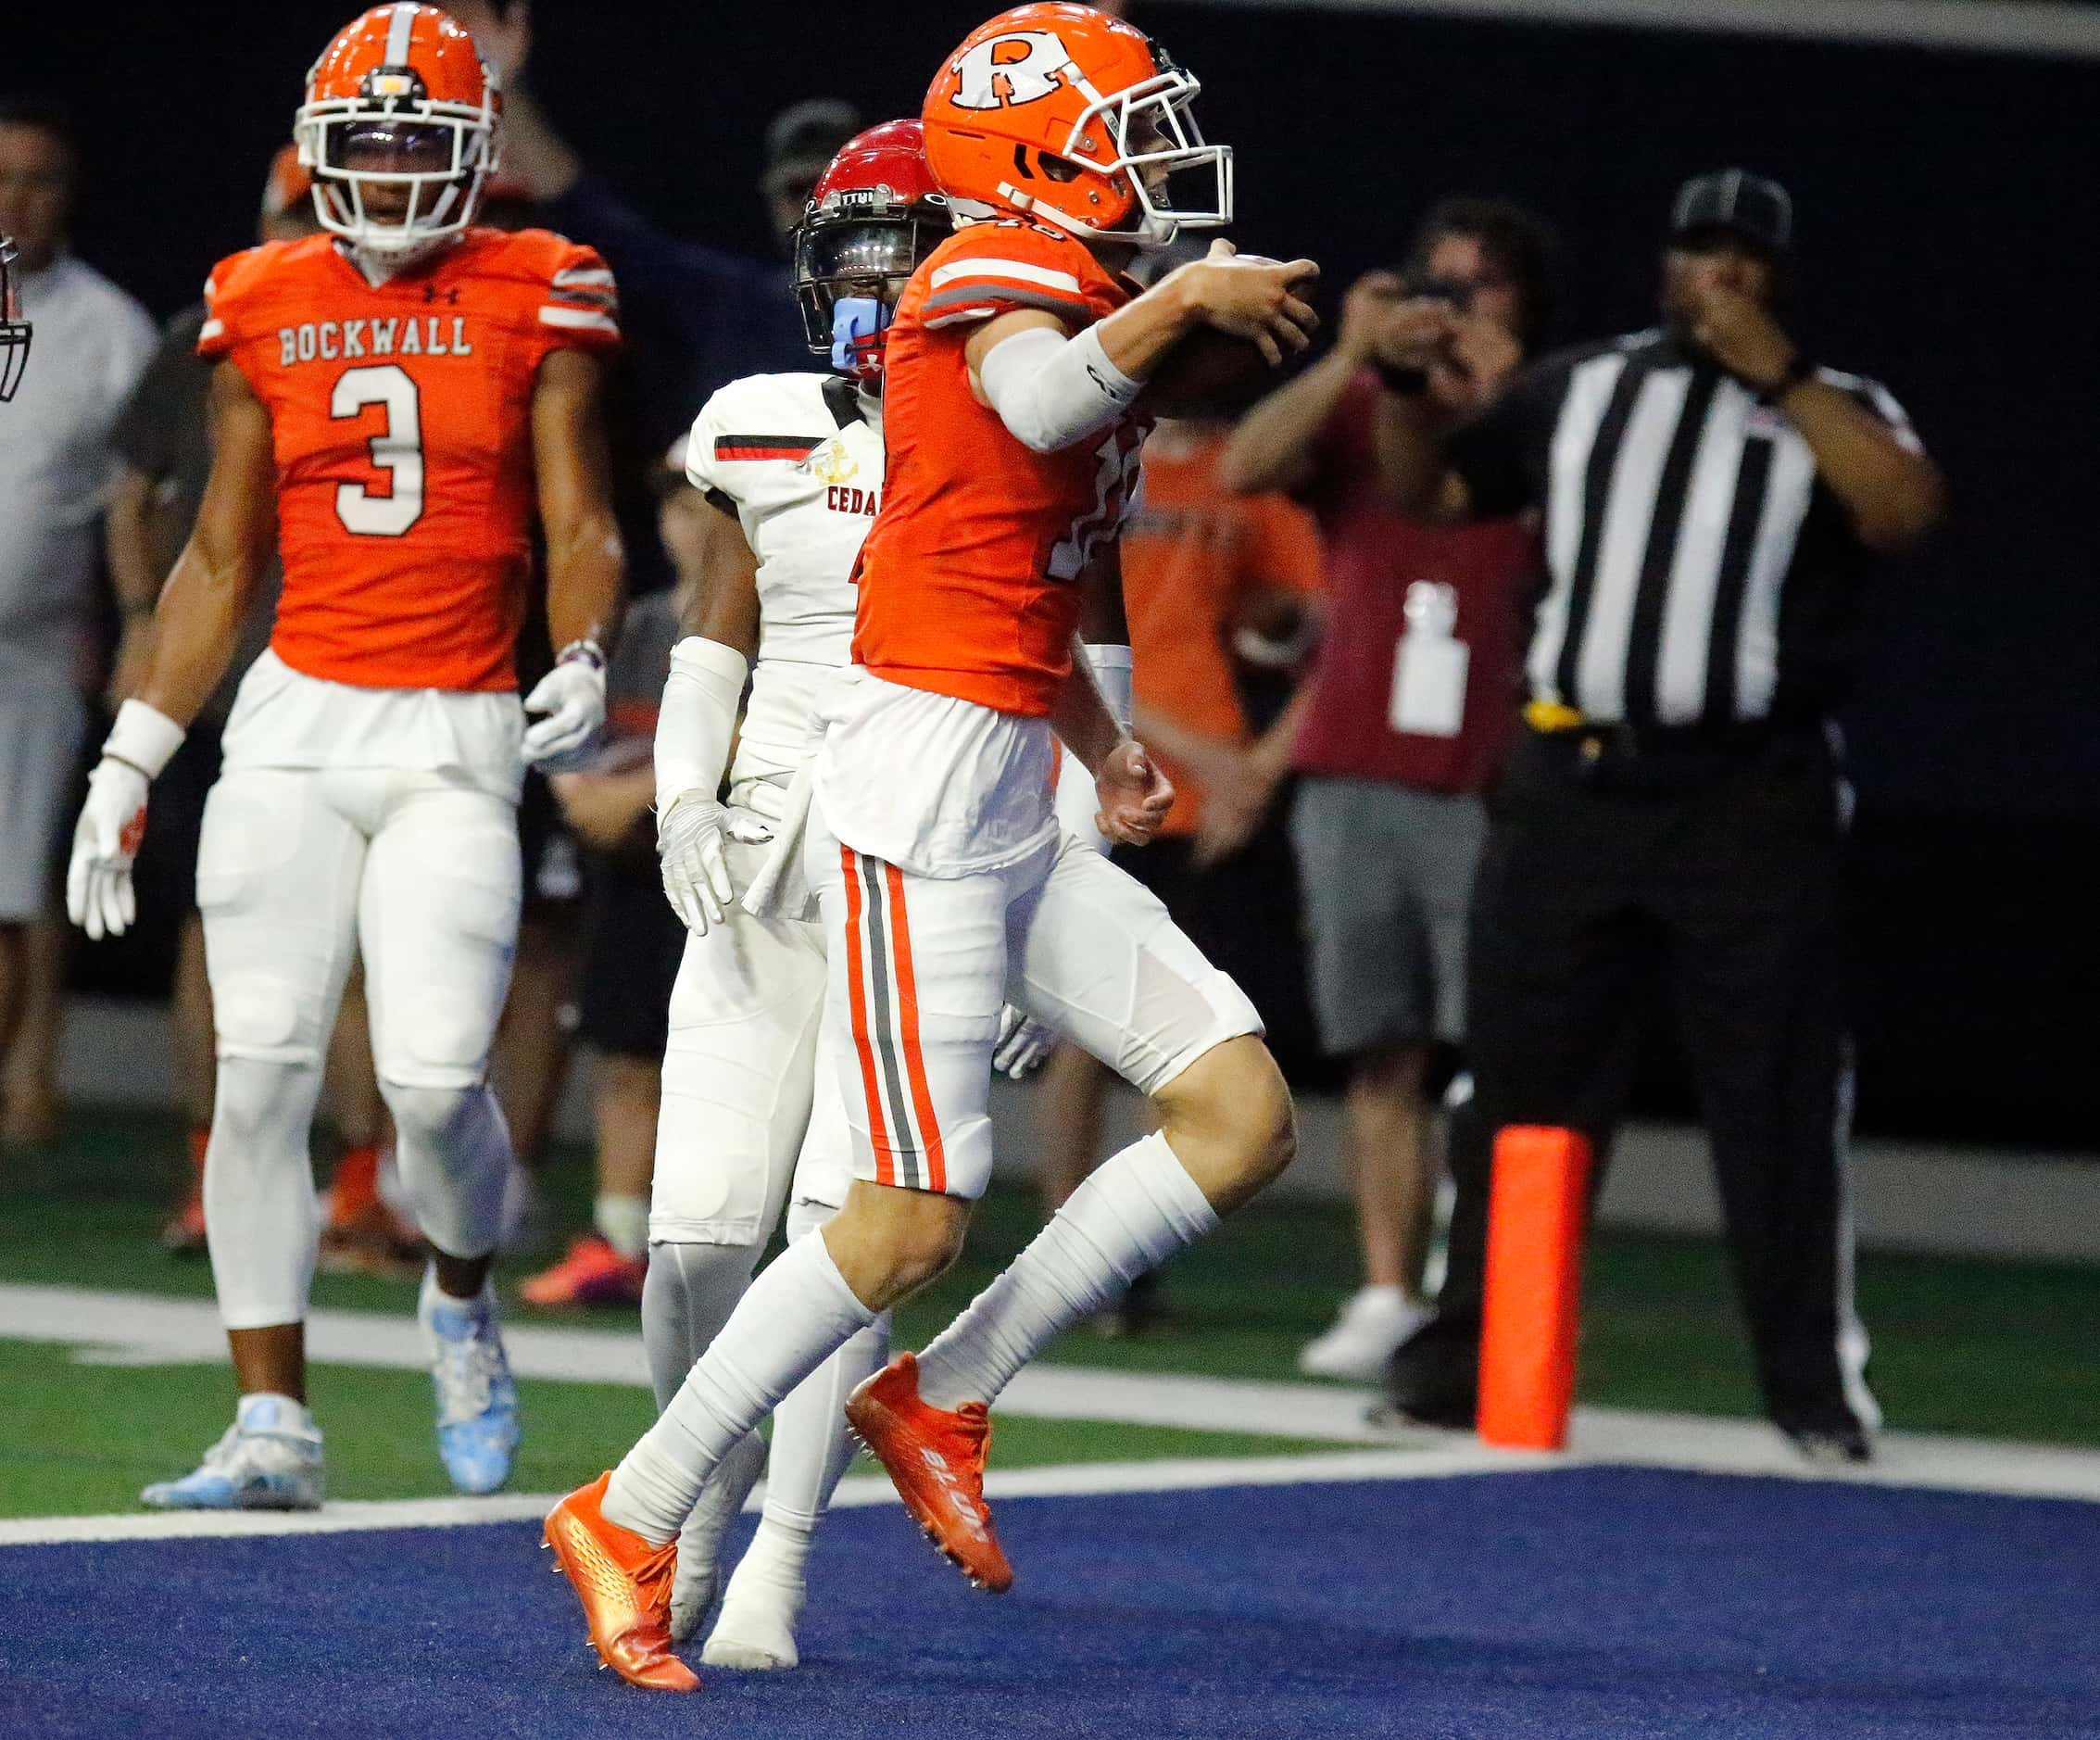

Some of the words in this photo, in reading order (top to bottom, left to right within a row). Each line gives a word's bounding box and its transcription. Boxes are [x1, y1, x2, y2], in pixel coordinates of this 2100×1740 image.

[949, 31, 1068, 110] R
[279, 316, 472, 366] ROCKWALL
[331, 363, 425, 537] 3
[827, 485, 883, 517] CEDA
